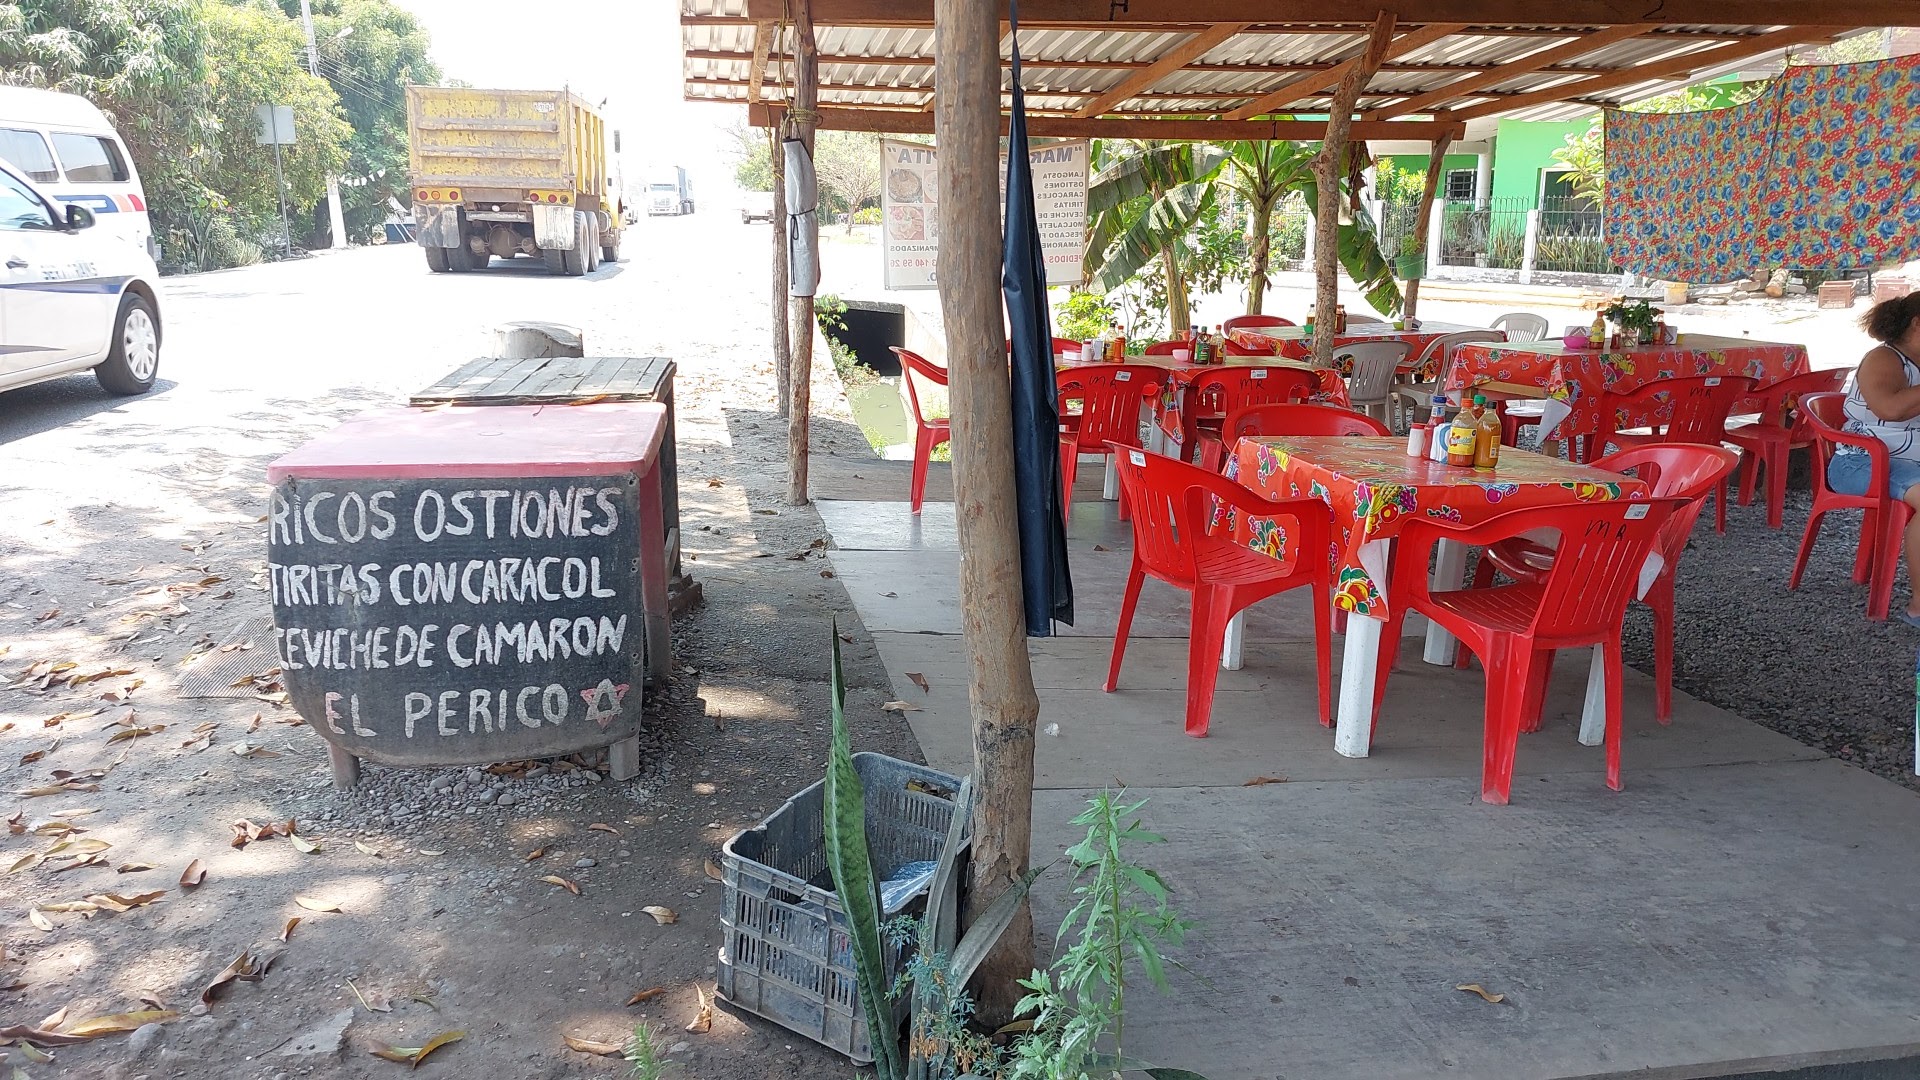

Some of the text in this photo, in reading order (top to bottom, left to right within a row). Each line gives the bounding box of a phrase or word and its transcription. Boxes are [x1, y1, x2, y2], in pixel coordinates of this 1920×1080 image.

[269, 485, 623, 547] RICOS OSTIONES
[268, 555, 617, 608] TIRITAS CON CARACOL
[274, 613, 628, 672] CEVICHE DE CAMARON
[325, 682, 569, 739] EL PERICO
